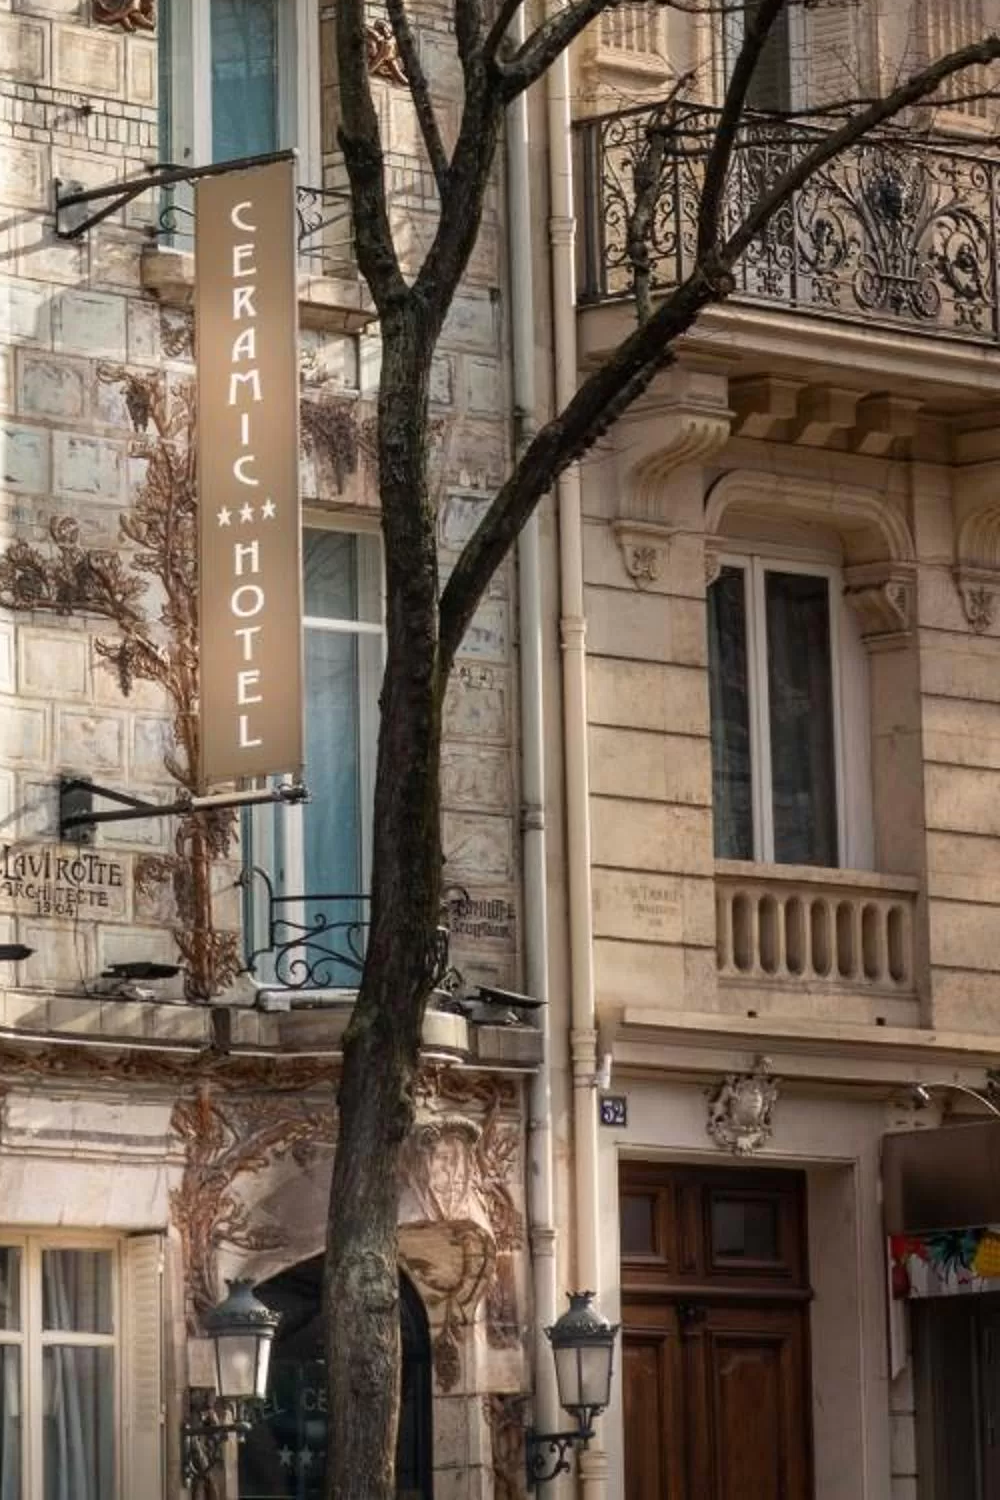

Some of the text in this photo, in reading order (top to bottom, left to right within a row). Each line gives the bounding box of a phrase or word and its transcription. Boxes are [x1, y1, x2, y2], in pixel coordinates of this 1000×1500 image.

[228, 201, 263, 486] CERAMIC
[231, 539, 265, 749] HOTEL
[0, 881, 109, 907] ARCHITECTE
